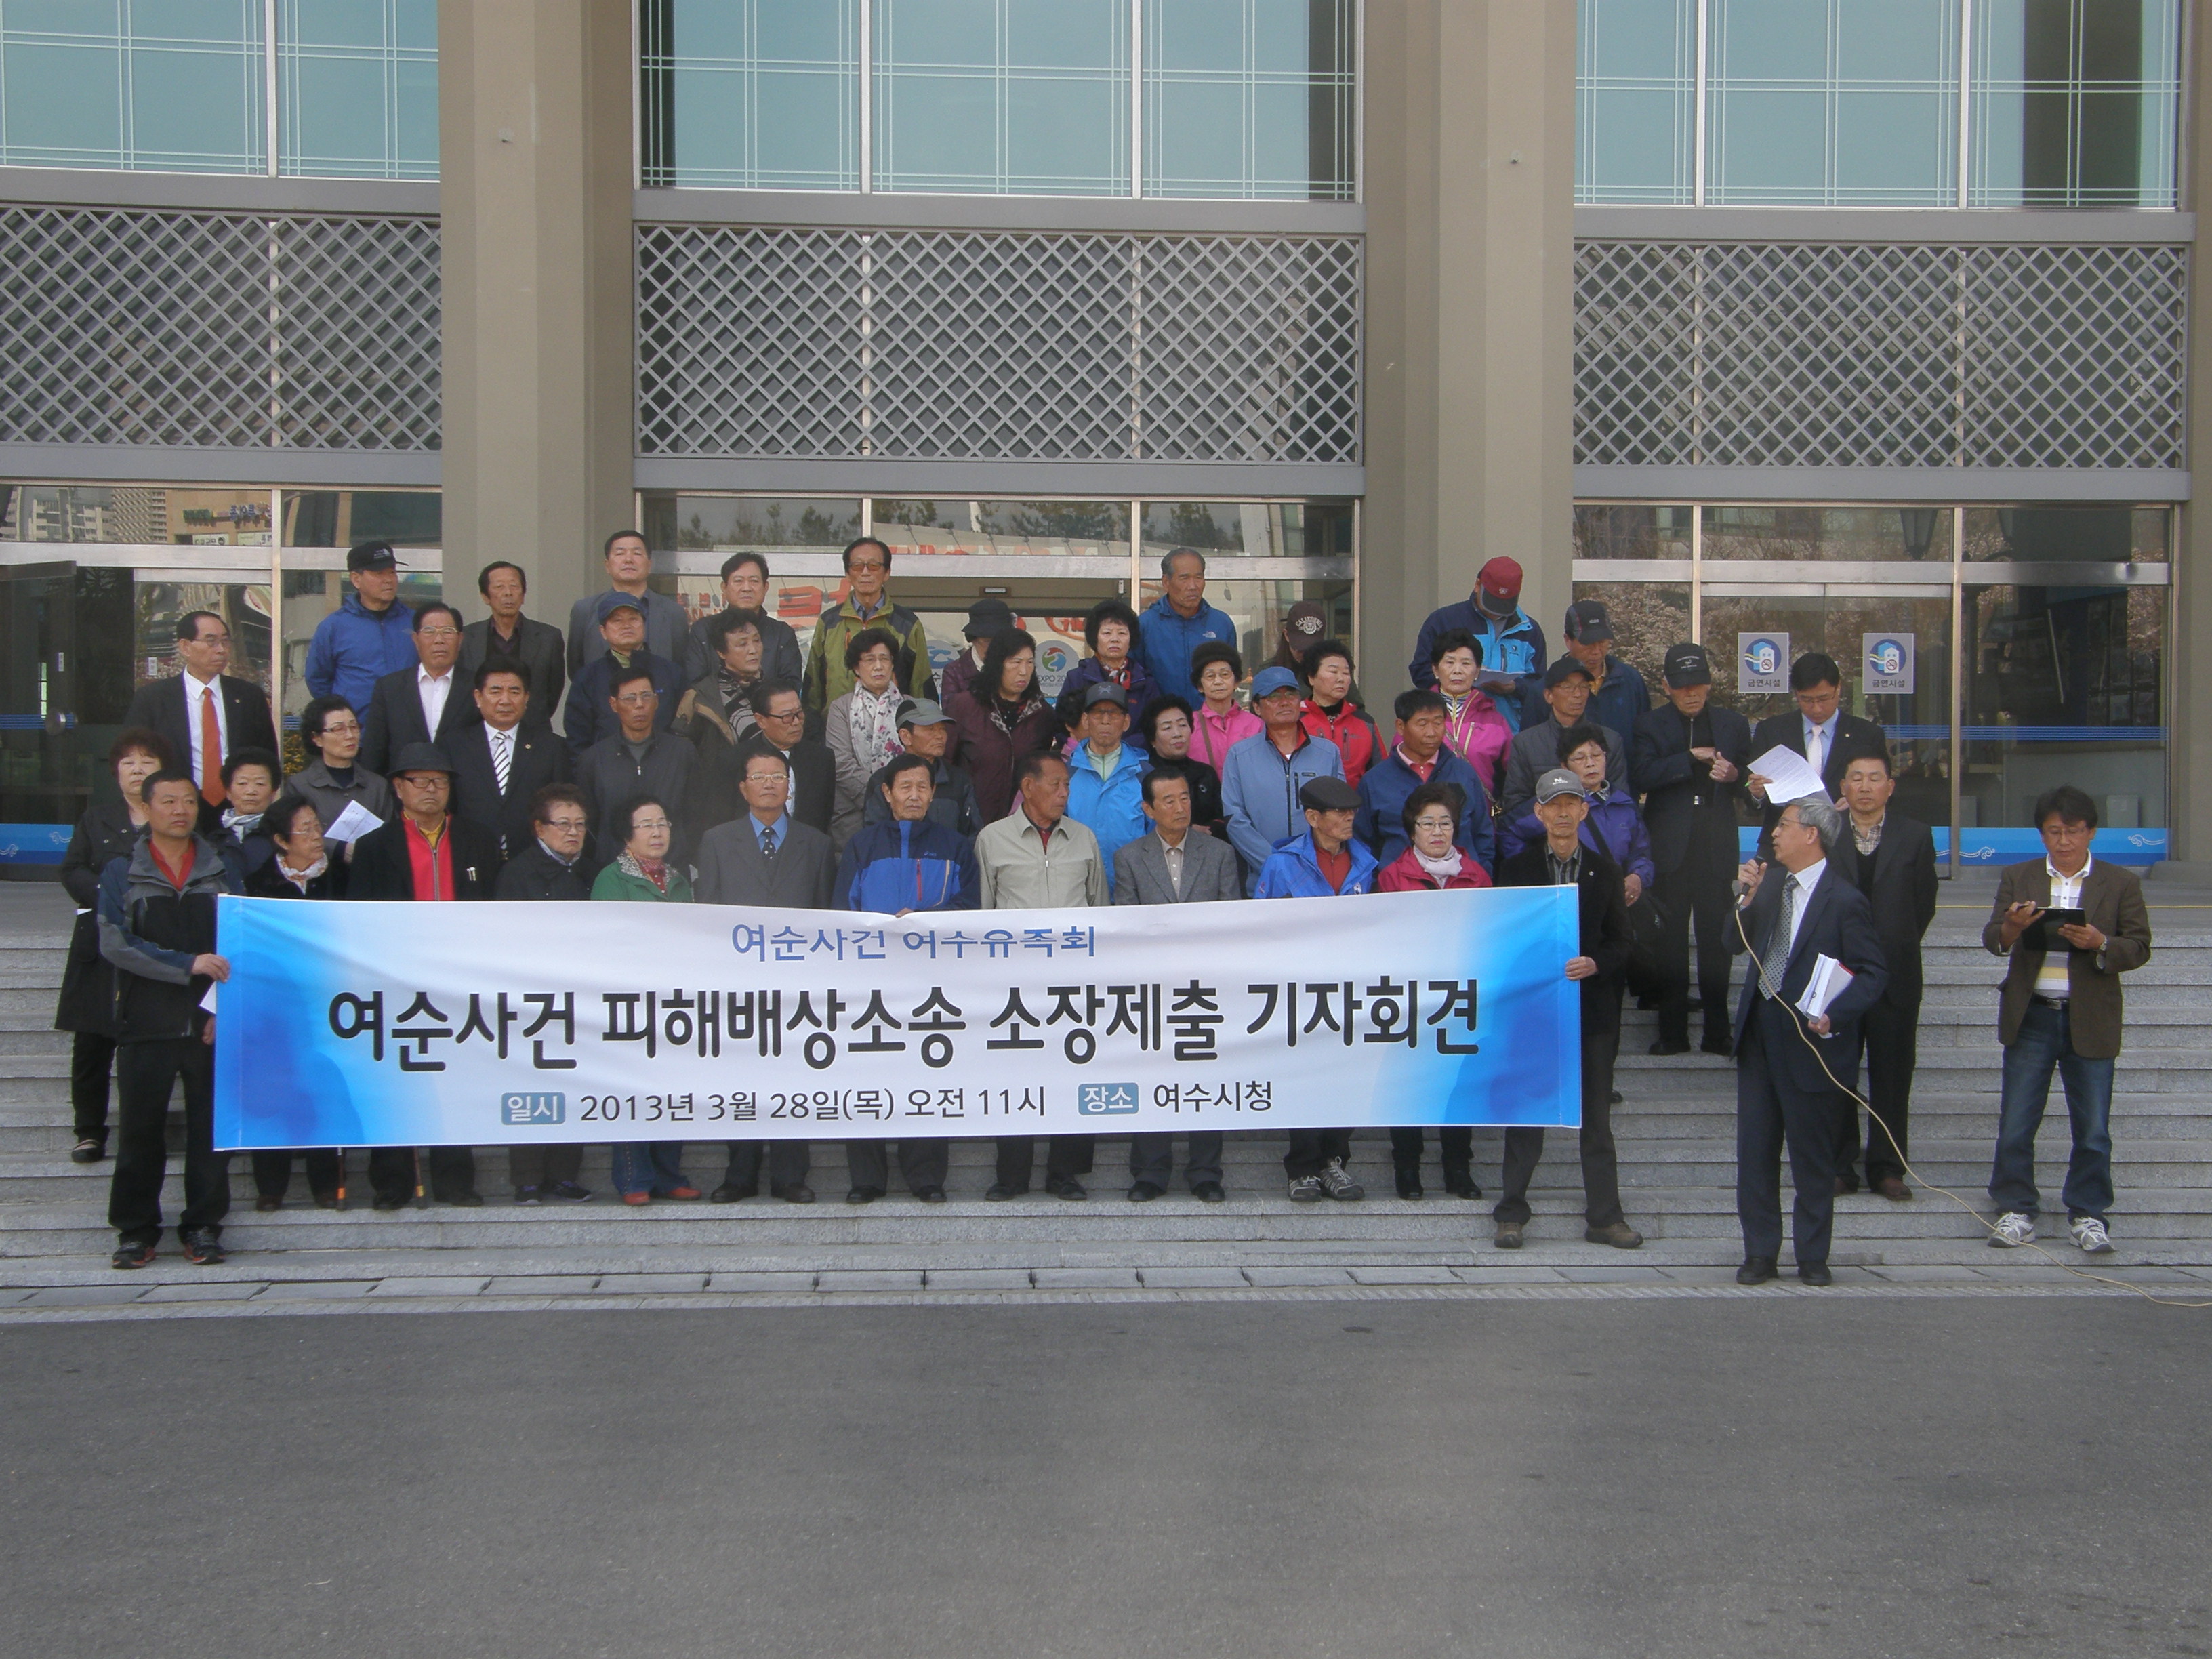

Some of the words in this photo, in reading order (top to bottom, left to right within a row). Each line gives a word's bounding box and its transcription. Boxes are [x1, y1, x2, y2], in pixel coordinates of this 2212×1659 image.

[1037, 674, 1056, 682] EXPO
[1747, 678, 1781, 688] 금연시설
[1872, 679, 1906, 689] 금연시설
[732, 924, 886, 962] 여순사건
[902, 926, 1095, 959] 여수유족회
[329, 990, 577, 1072] 여순사건
[602, 987, 967, 1069] 피해배상소송
[987, 979, 1224, 1065] 소장제출
[1246, 975, 1479, 1055] 기자회견
[507, 1095, 558, 1122] 일시
[580, 1092, 694, 1122] 2013년
[708, 1092, 757, 1121] 3월
[770, 1088, 895, 1122] 28일(목)
[904, 1088, 965, 1118] 오전
[978, 1086, 1045, 1117] 11시
[1084, 1086, 1134, 1111] 장소
[1153, 1080, 1273, 1113] 여수시청
